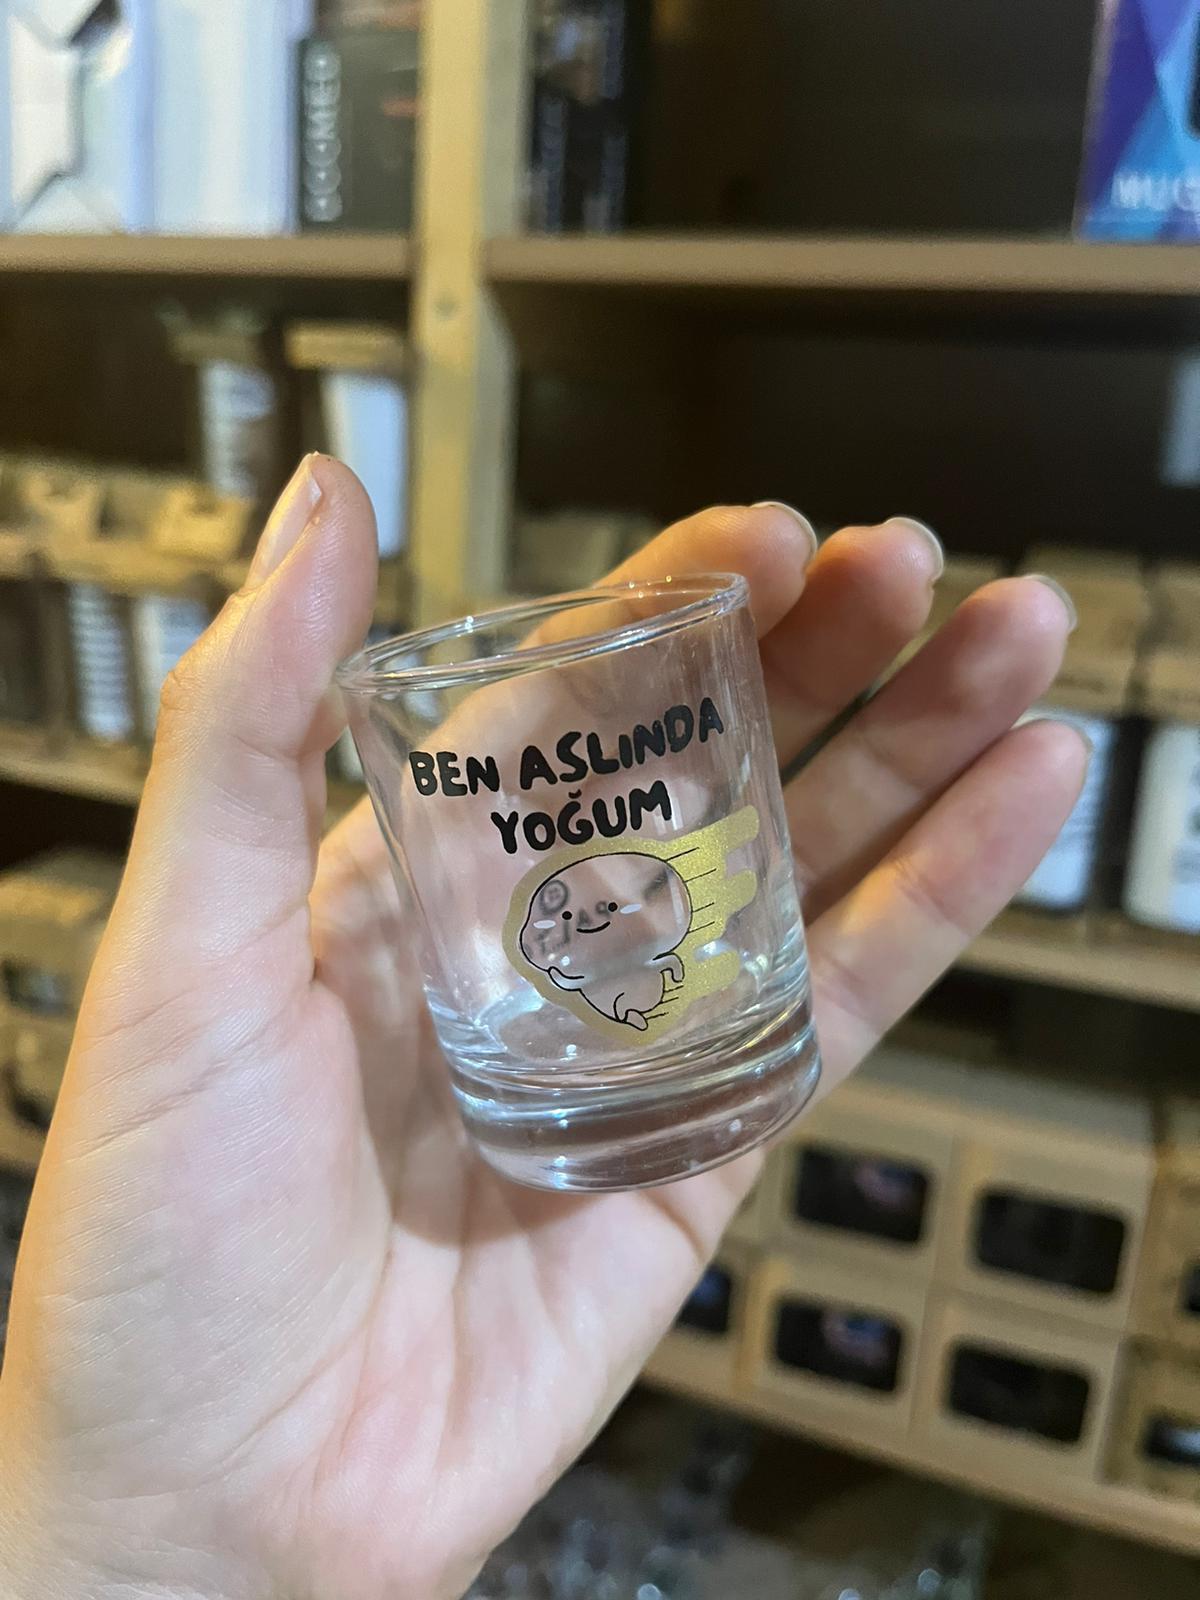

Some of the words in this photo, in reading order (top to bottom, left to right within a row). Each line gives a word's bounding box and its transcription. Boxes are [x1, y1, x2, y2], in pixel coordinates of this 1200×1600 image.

[409, 751, 500, 796] BEN
[520, 697, 724, 790] ASLINDA
[491, 780, 672, 854] YOĞUM
